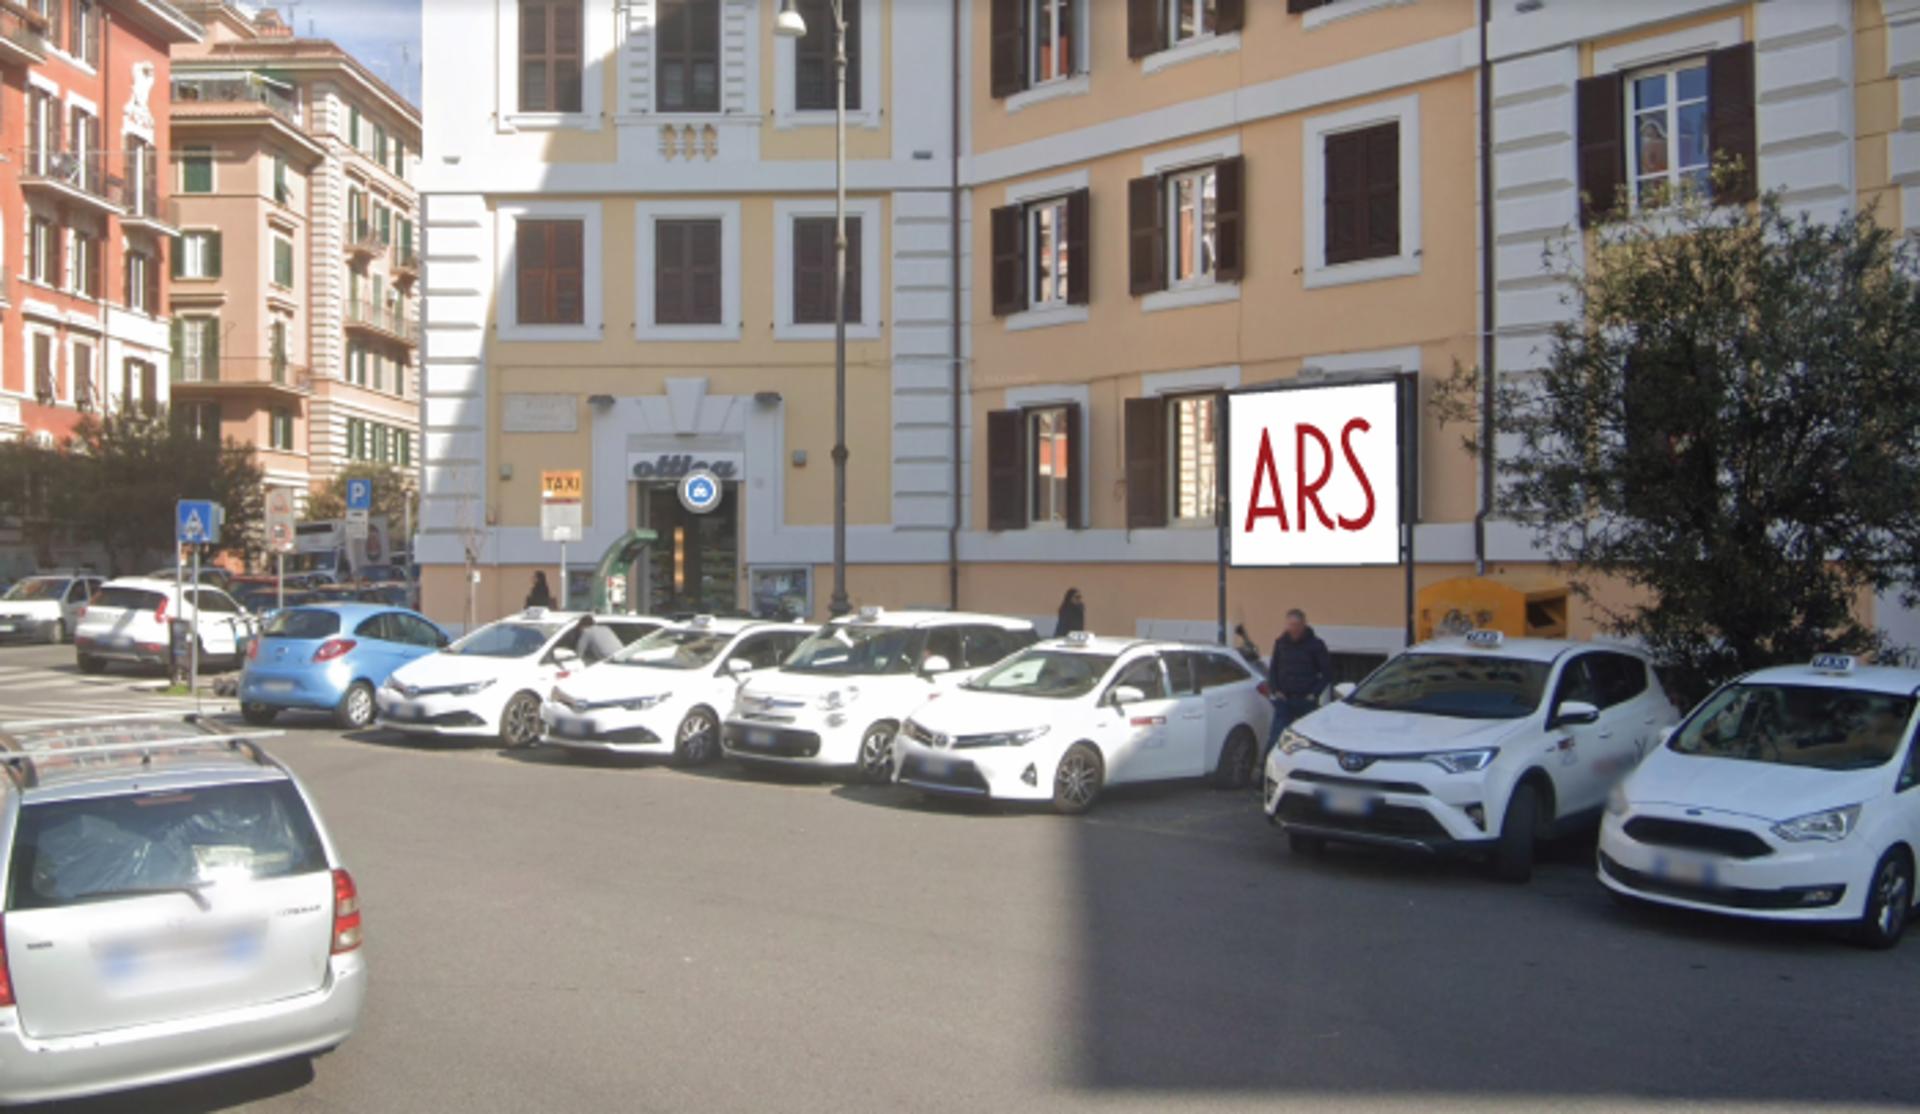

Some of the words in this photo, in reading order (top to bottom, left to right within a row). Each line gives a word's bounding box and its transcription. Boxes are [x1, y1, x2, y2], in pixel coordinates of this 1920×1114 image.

[545, 477, 580, 492] TAXI
[1245, 417, 1376, 533] ARS
[351, 482, 366, 505] P
